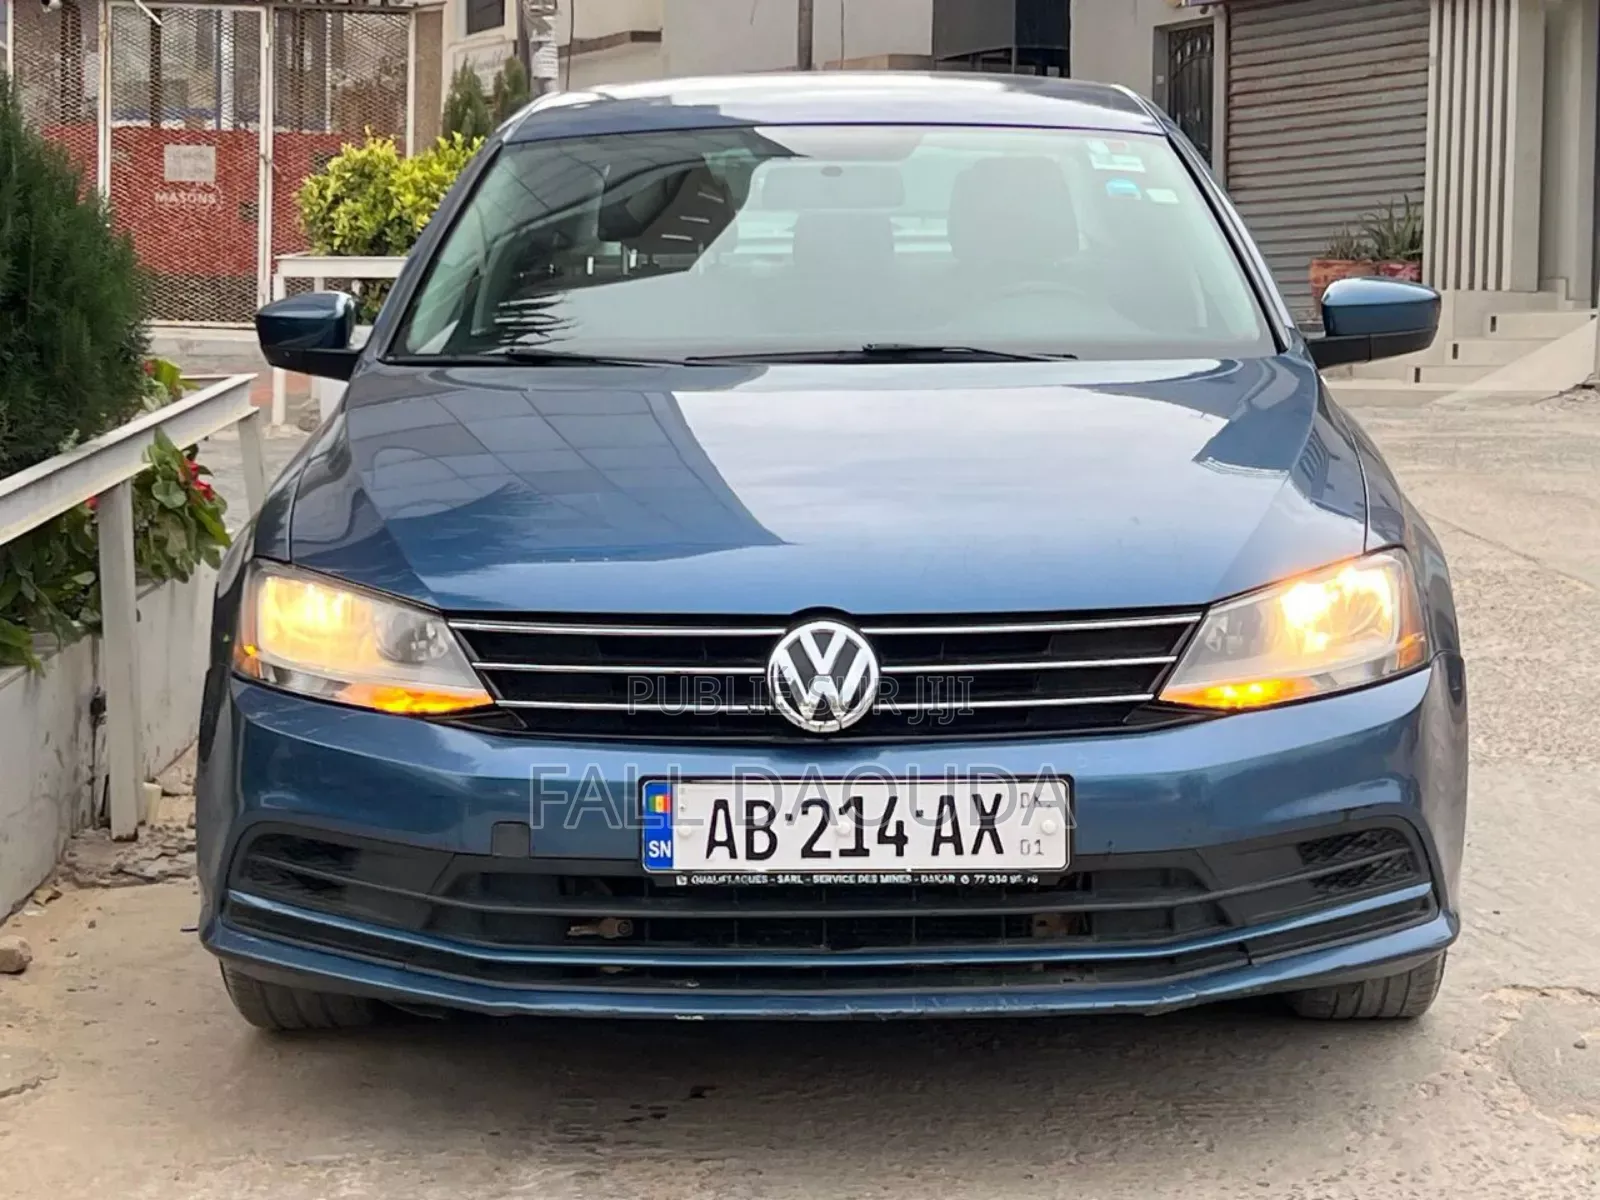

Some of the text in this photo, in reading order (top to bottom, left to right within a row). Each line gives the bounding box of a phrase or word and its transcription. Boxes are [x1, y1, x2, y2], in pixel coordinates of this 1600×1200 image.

[649, 840, 671, 858] SN
[1020, 838, 1044, 856] 01
[777, 875, 803, 885] SARL
[812, 875, 857, 885] SERVICE
[858, 875, 877, 884] DES
[880, 875, 912, 884] MINES
[920, 875, 956, 884] DAKAR
